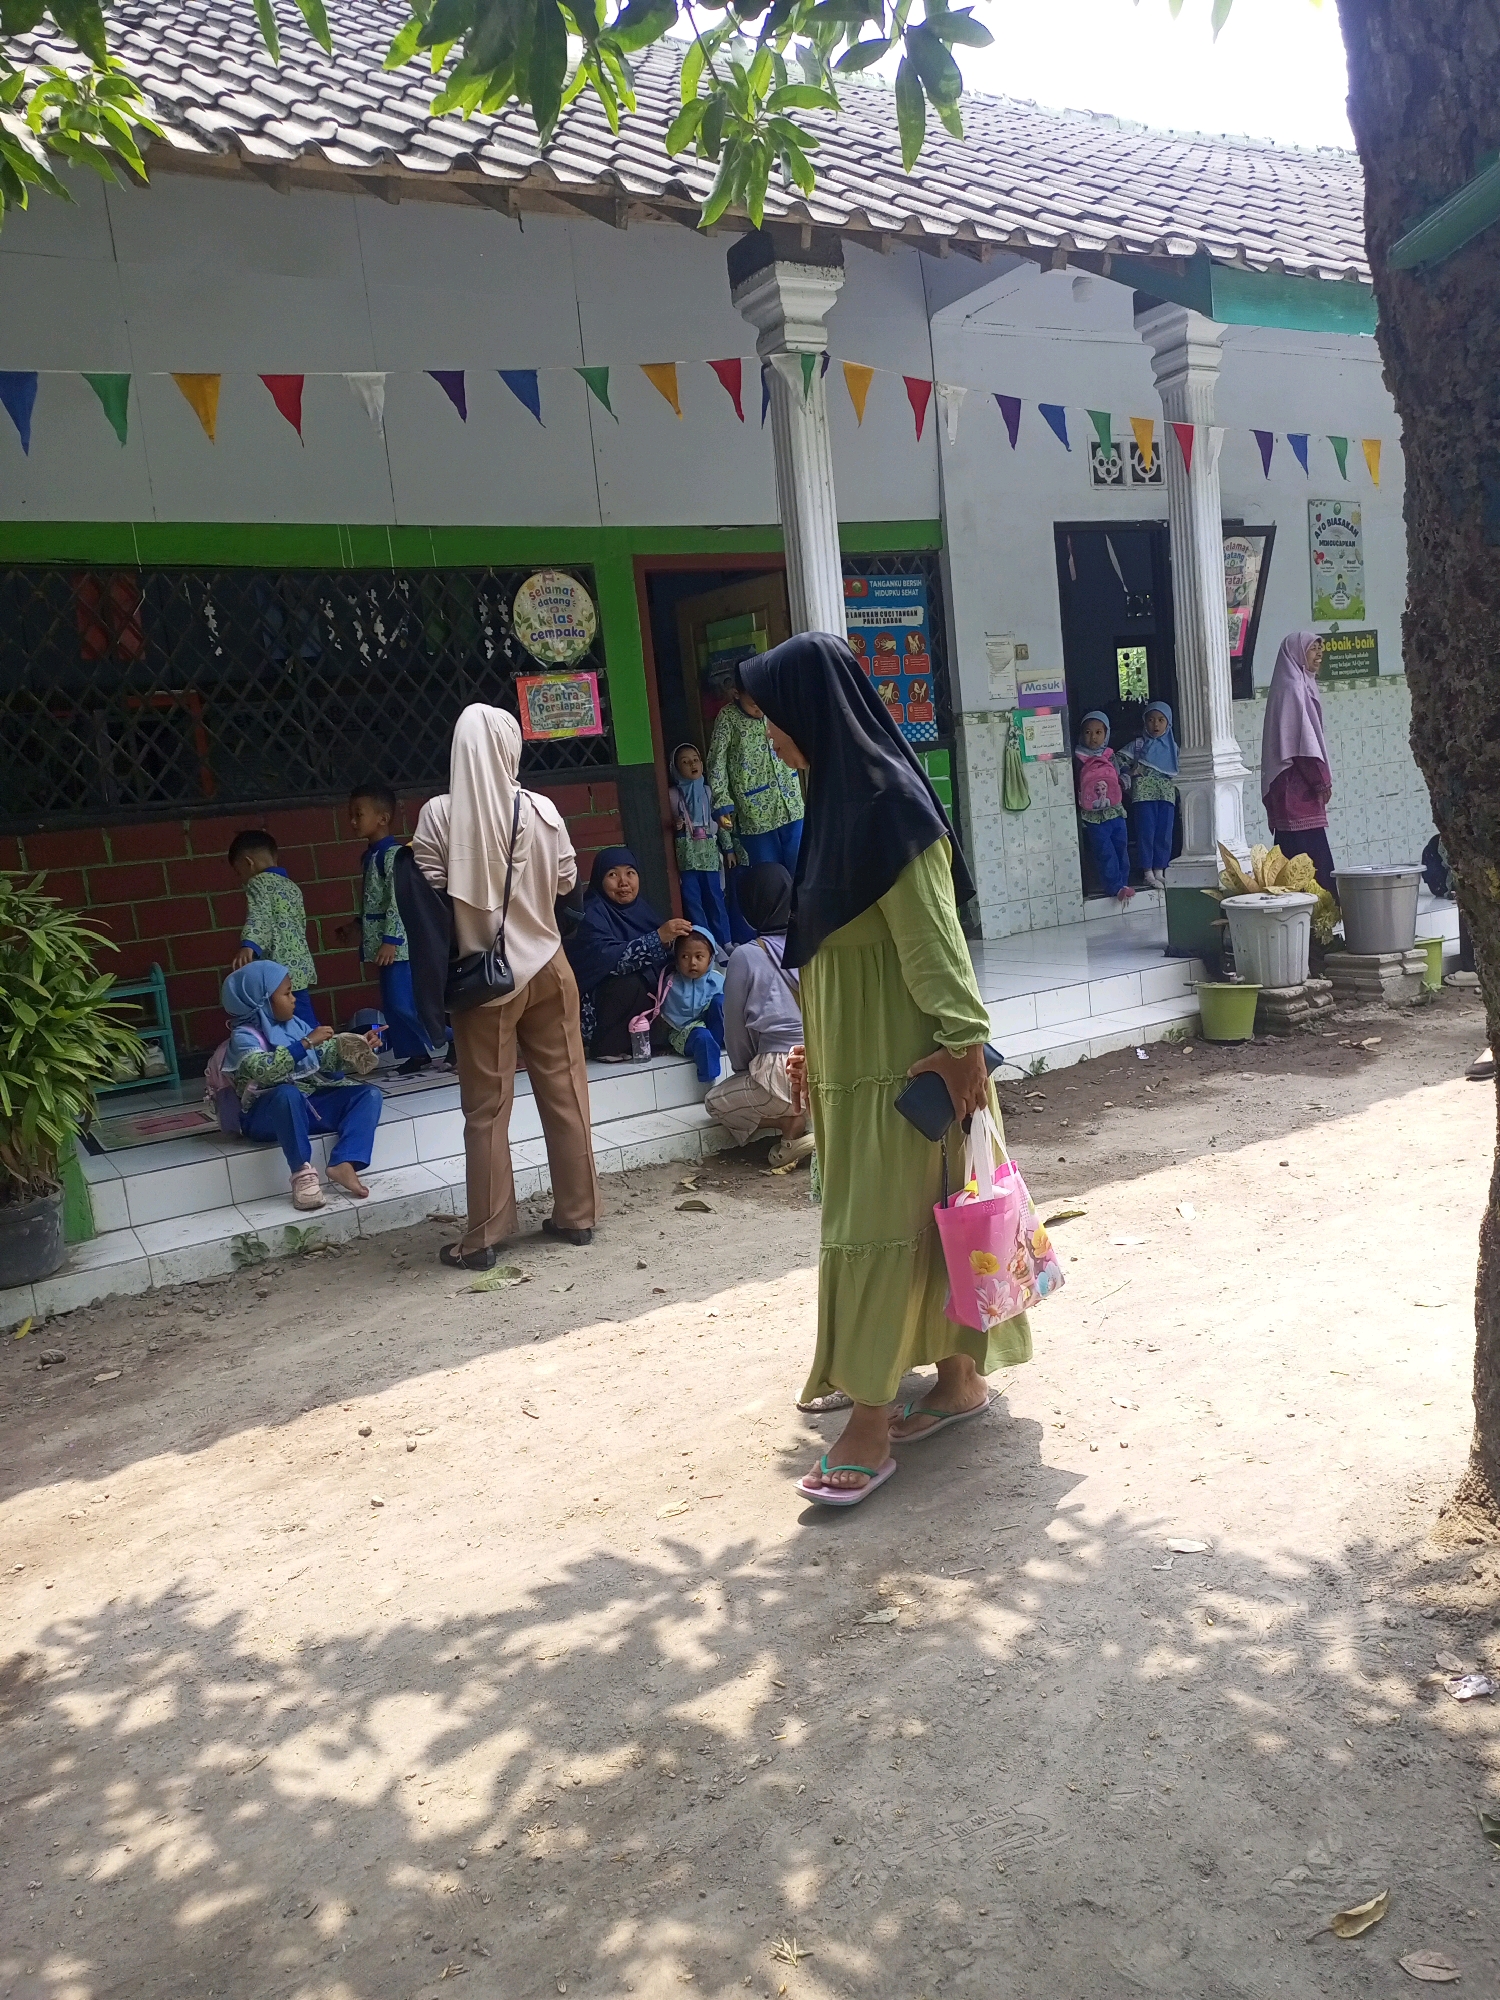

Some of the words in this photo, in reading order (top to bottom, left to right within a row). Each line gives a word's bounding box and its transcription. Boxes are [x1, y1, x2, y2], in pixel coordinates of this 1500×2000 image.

[1326, 517, 1359, 538] BIASAKAN
[1223, 542, 1250, 554] elamat
[870, 580, 901, 588] TANGANKU
[874, 589, 900, 597] HIDUPKU
[538, 597, 571, 607] datang
[538, 613, 574, 626] kelas
[530, 626, 586, 642] cempaka
[1025, 681, 1060, 691] Masuk
[541, 690, 579, 703] Sentra
